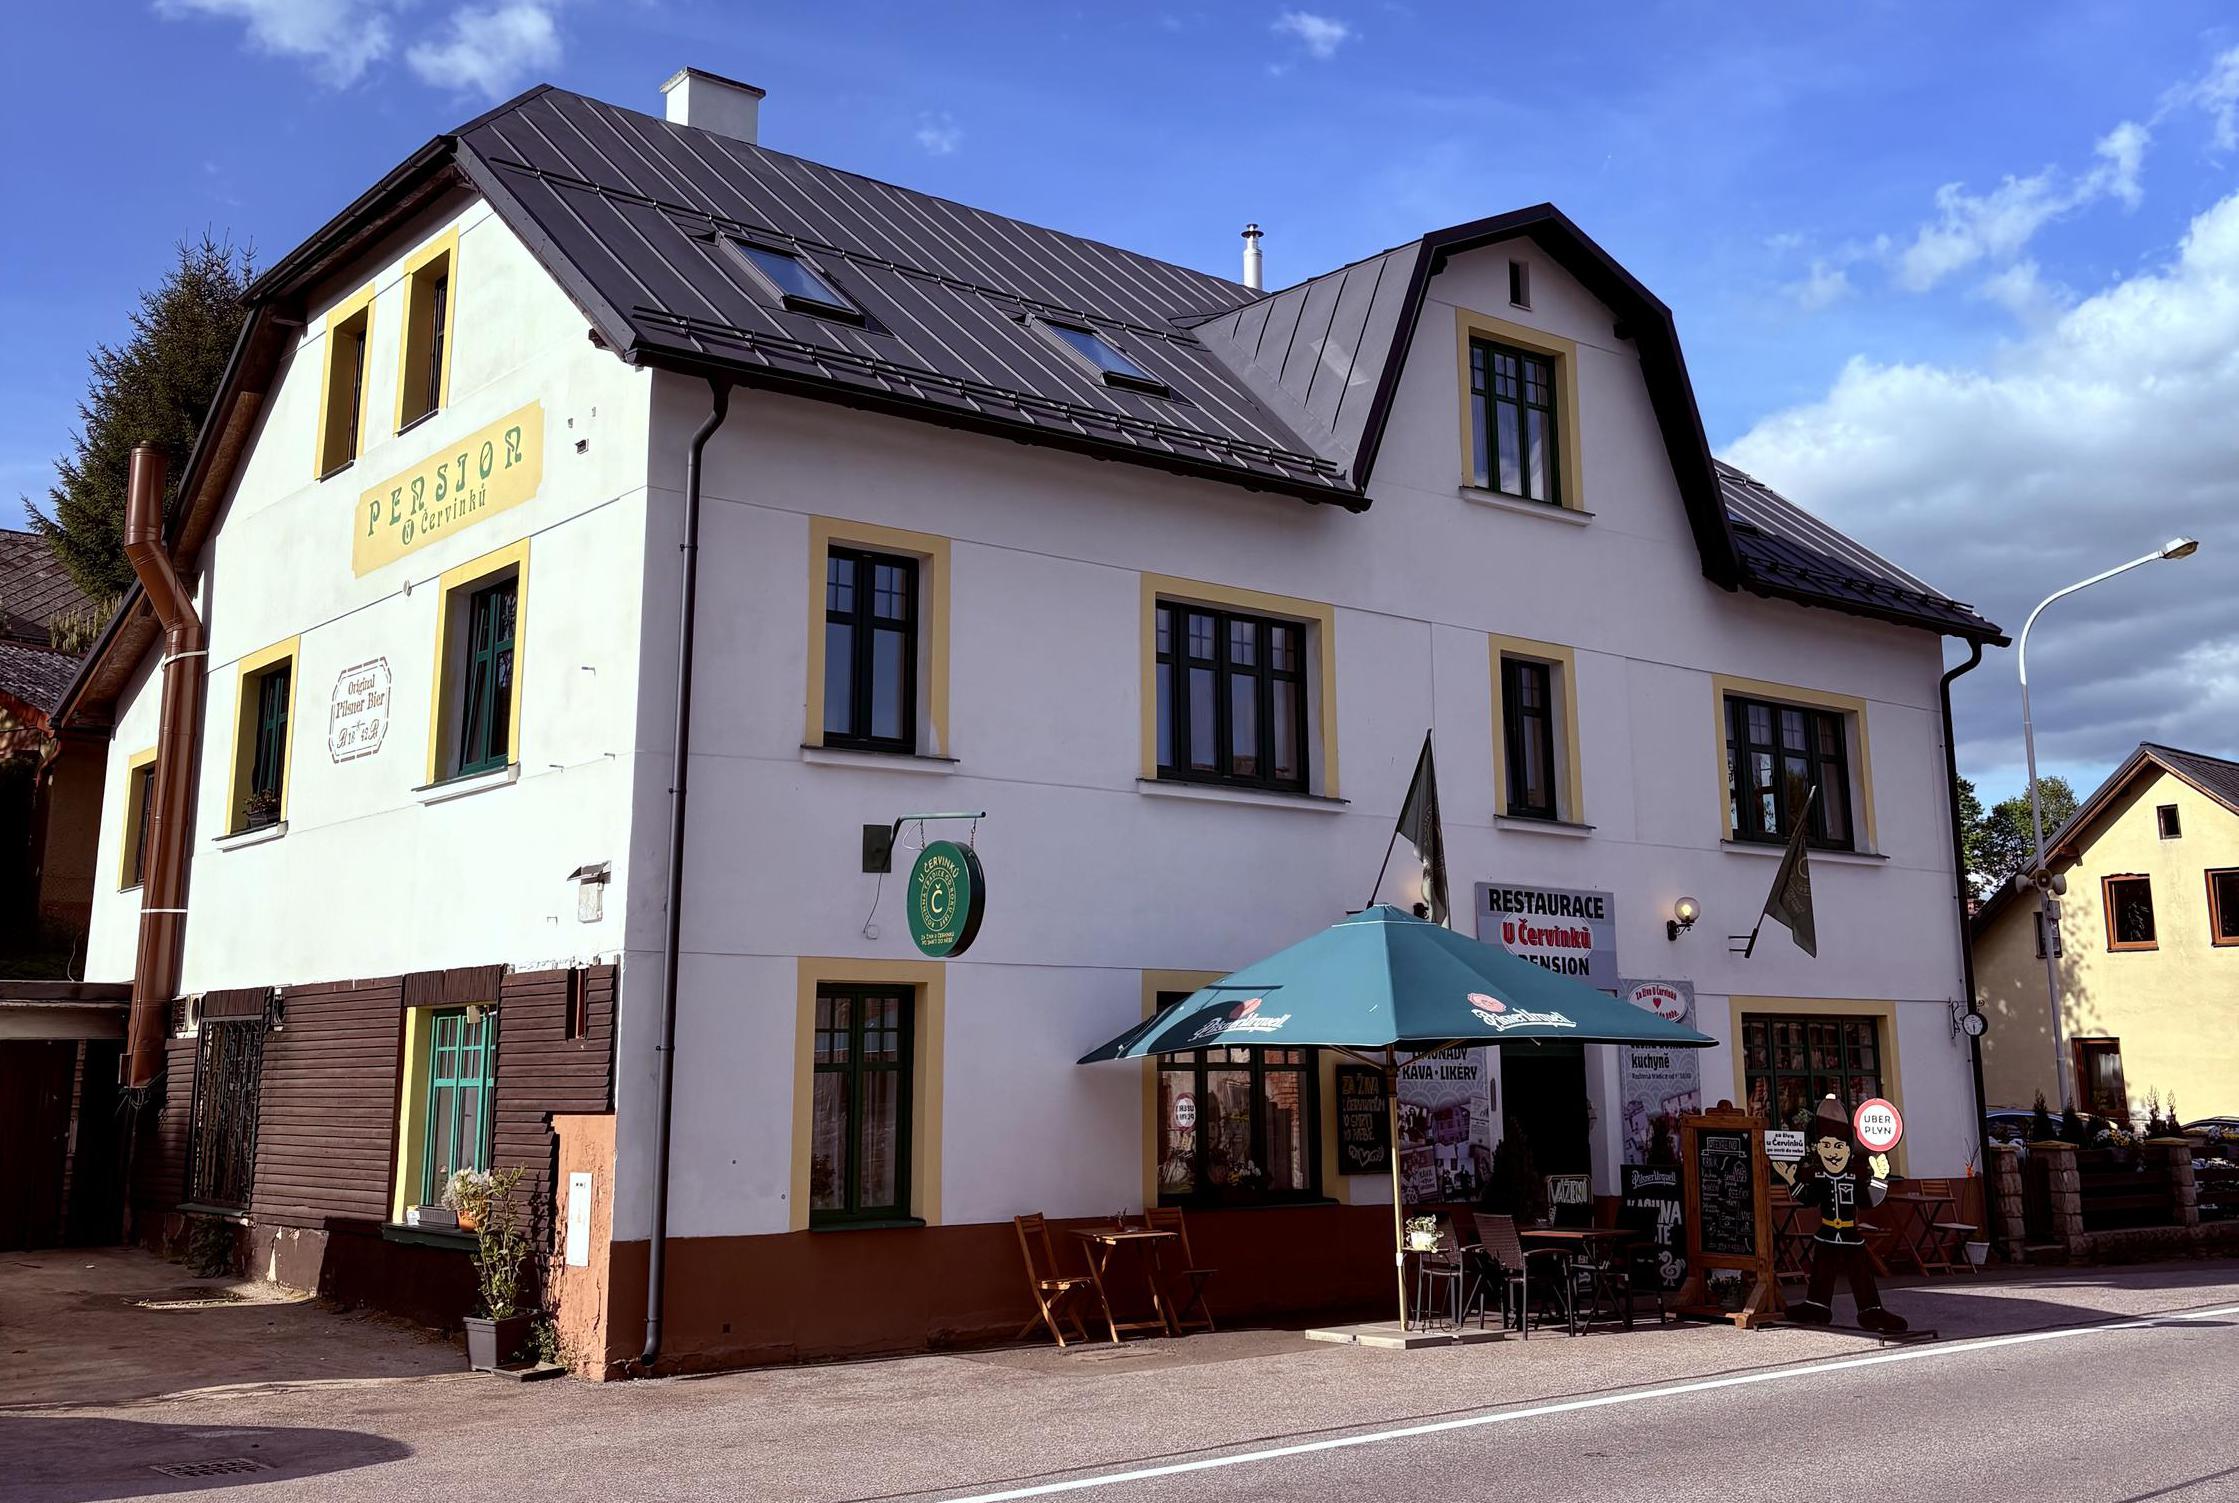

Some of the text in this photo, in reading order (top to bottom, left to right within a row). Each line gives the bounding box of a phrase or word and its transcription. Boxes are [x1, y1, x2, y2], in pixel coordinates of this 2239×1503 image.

[367, 425, 523, 538] PENSION
[348, 673, 376, 695] Original
[335, 691, 385, 719] Pilsner Bier
[918, 873, 925, 883] U
[931, 883, 943, 913] Č
[1488, 888, 1605, 919] RESTAURACE
[1502, 917, 1592, 950] U Červinků
[1402, 1062, 1478, 1080] KÁVA LIKÉRY
[1631, 1052, 1670, 1071] kuchyně
[1863, 1114, 1891, 1124] UBER
[1864, 1126, 1892, 1135] PLYN
